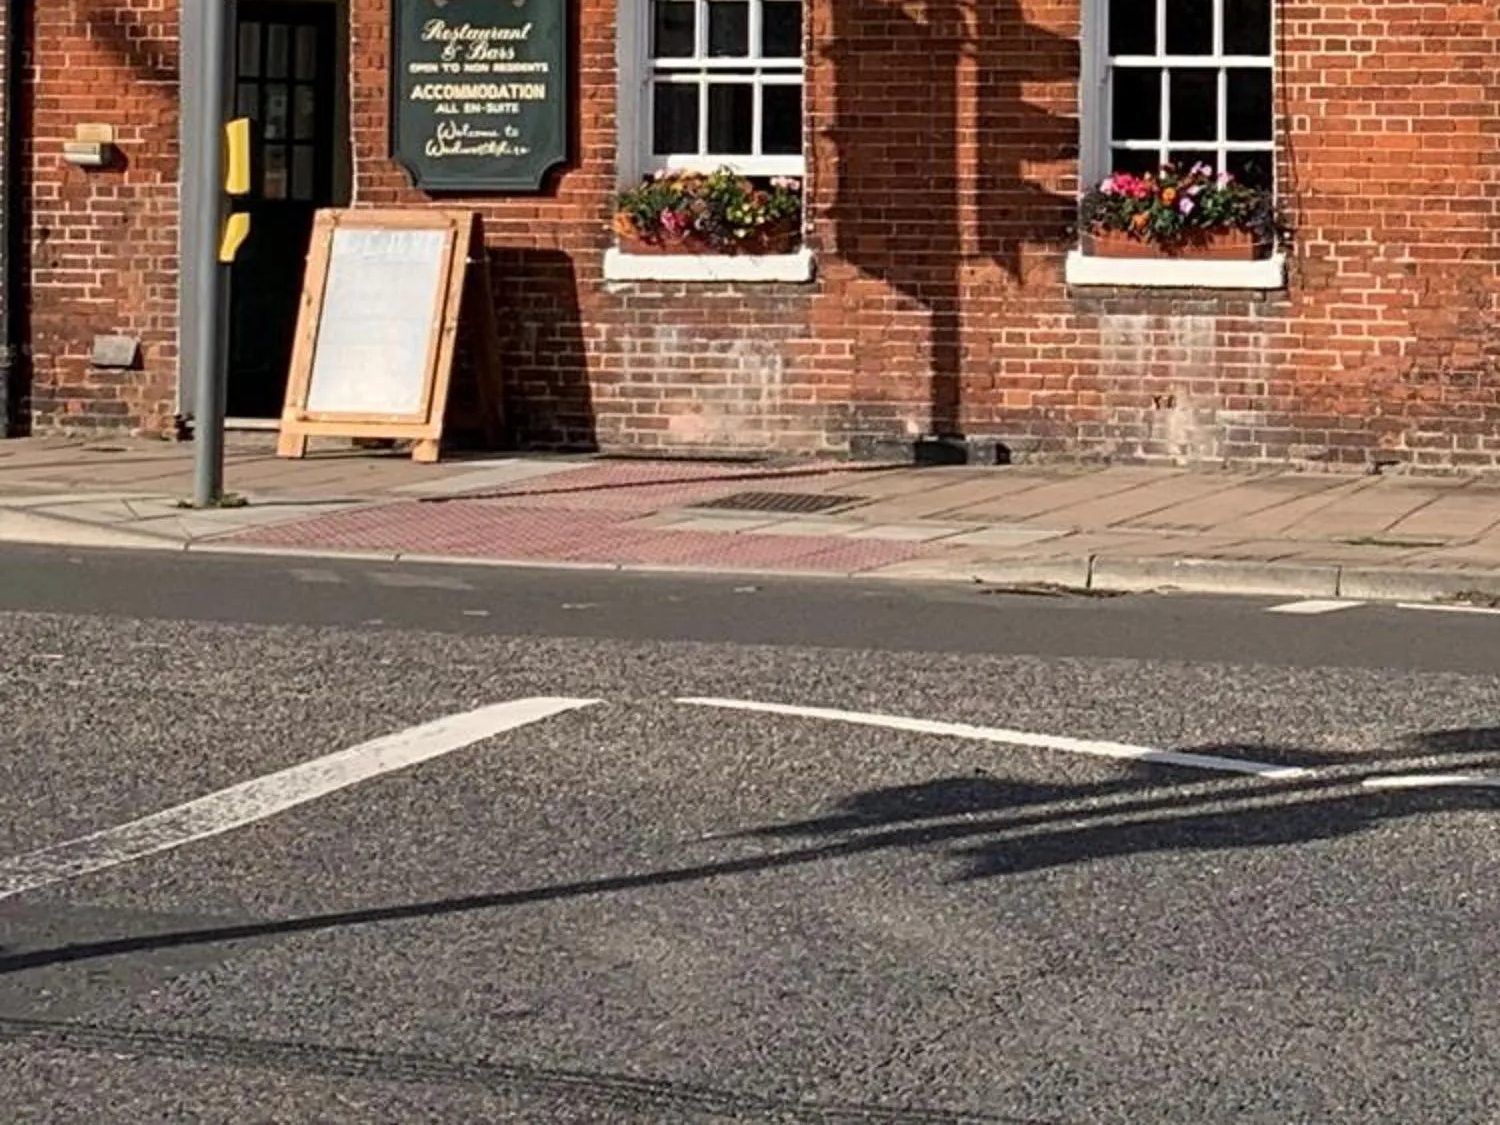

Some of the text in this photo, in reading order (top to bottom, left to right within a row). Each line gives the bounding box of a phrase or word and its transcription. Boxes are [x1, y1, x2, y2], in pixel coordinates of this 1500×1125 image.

[421, 18, 533, 43] Restaurant
[441, 40, 516, 61] & Bars
[409, 61, 550, 74] OPEN TO NON RESIDENTS
[410, 83, 547, 101] ACCOMMODATION
[434, 102, 520, 115] ALL EN-SUITE
